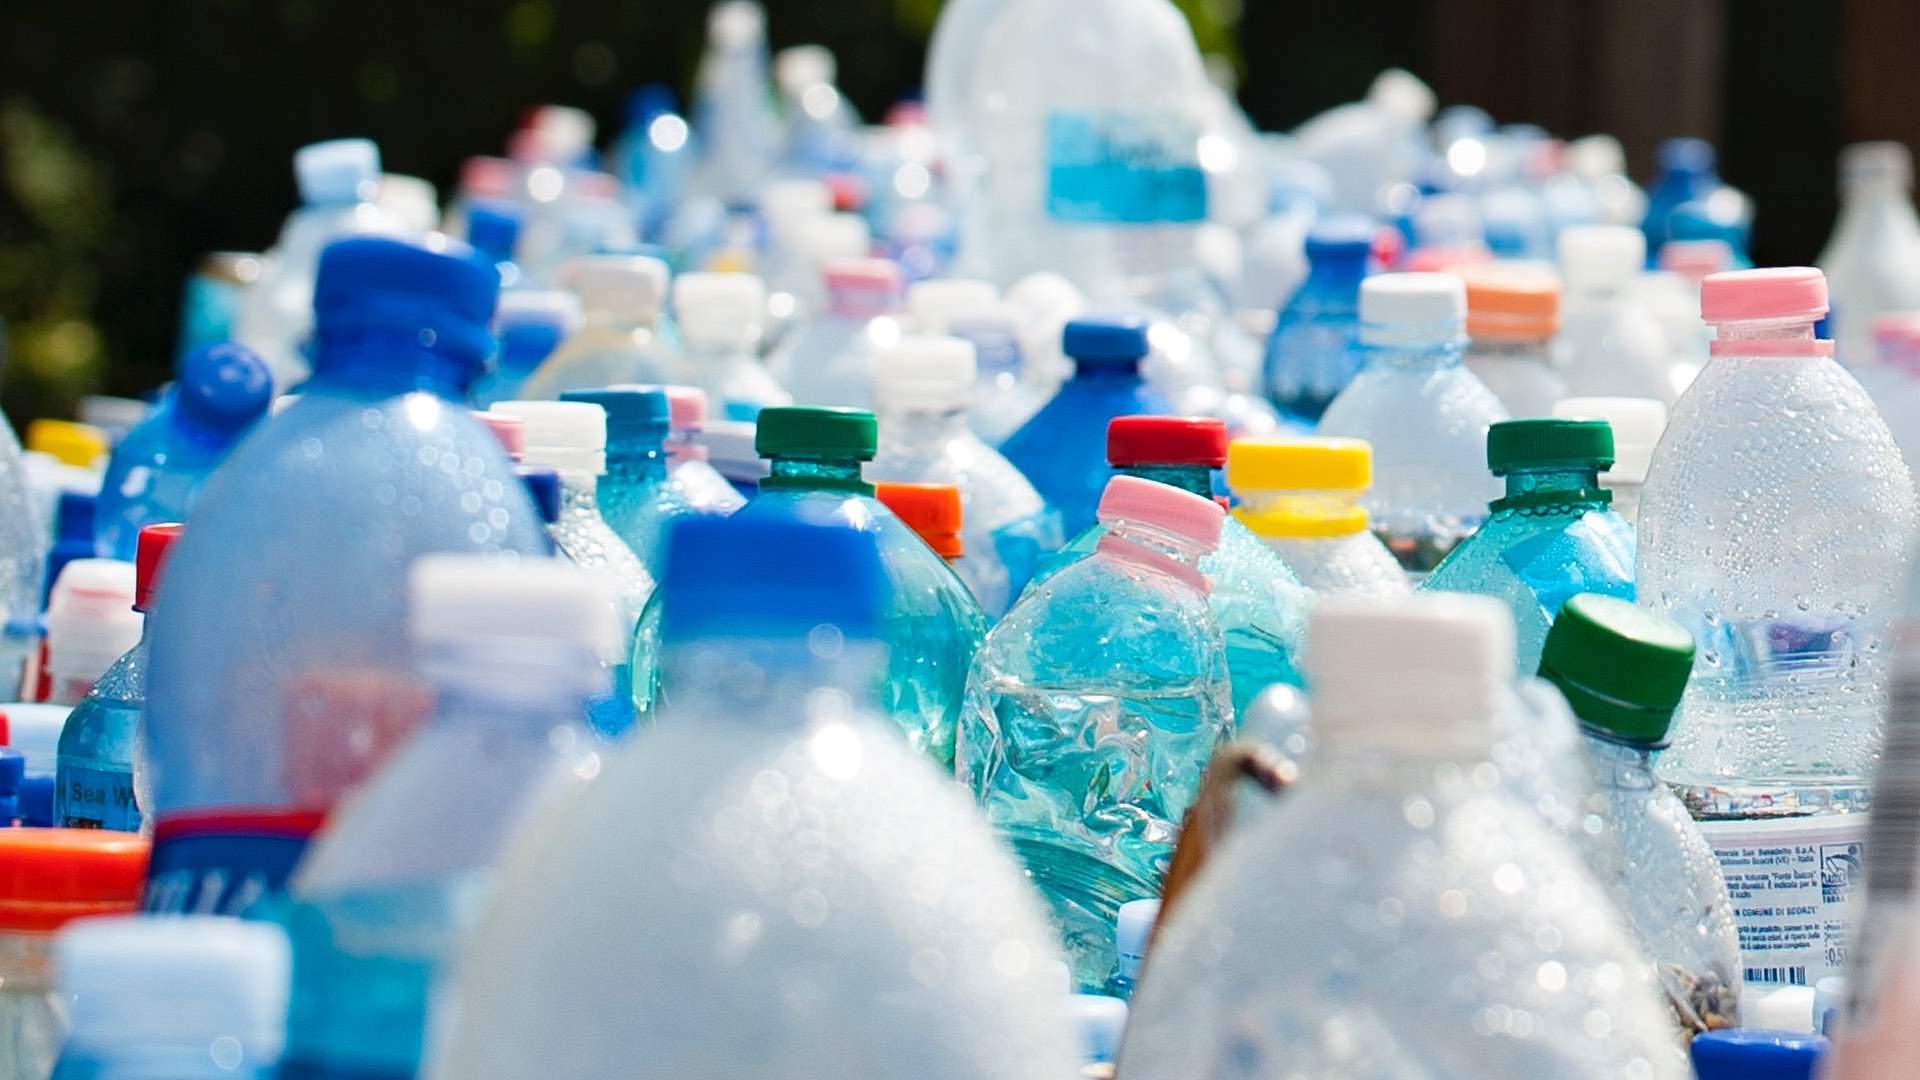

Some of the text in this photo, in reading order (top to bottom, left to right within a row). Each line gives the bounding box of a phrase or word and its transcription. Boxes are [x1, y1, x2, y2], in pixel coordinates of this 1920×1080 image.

[71, 783, 105, 806] Sea
[1742, 848, 1755, 857] San
[1742, 907, 1773, 917] COMUNE
[1775, 906, 1785, 917] DI
